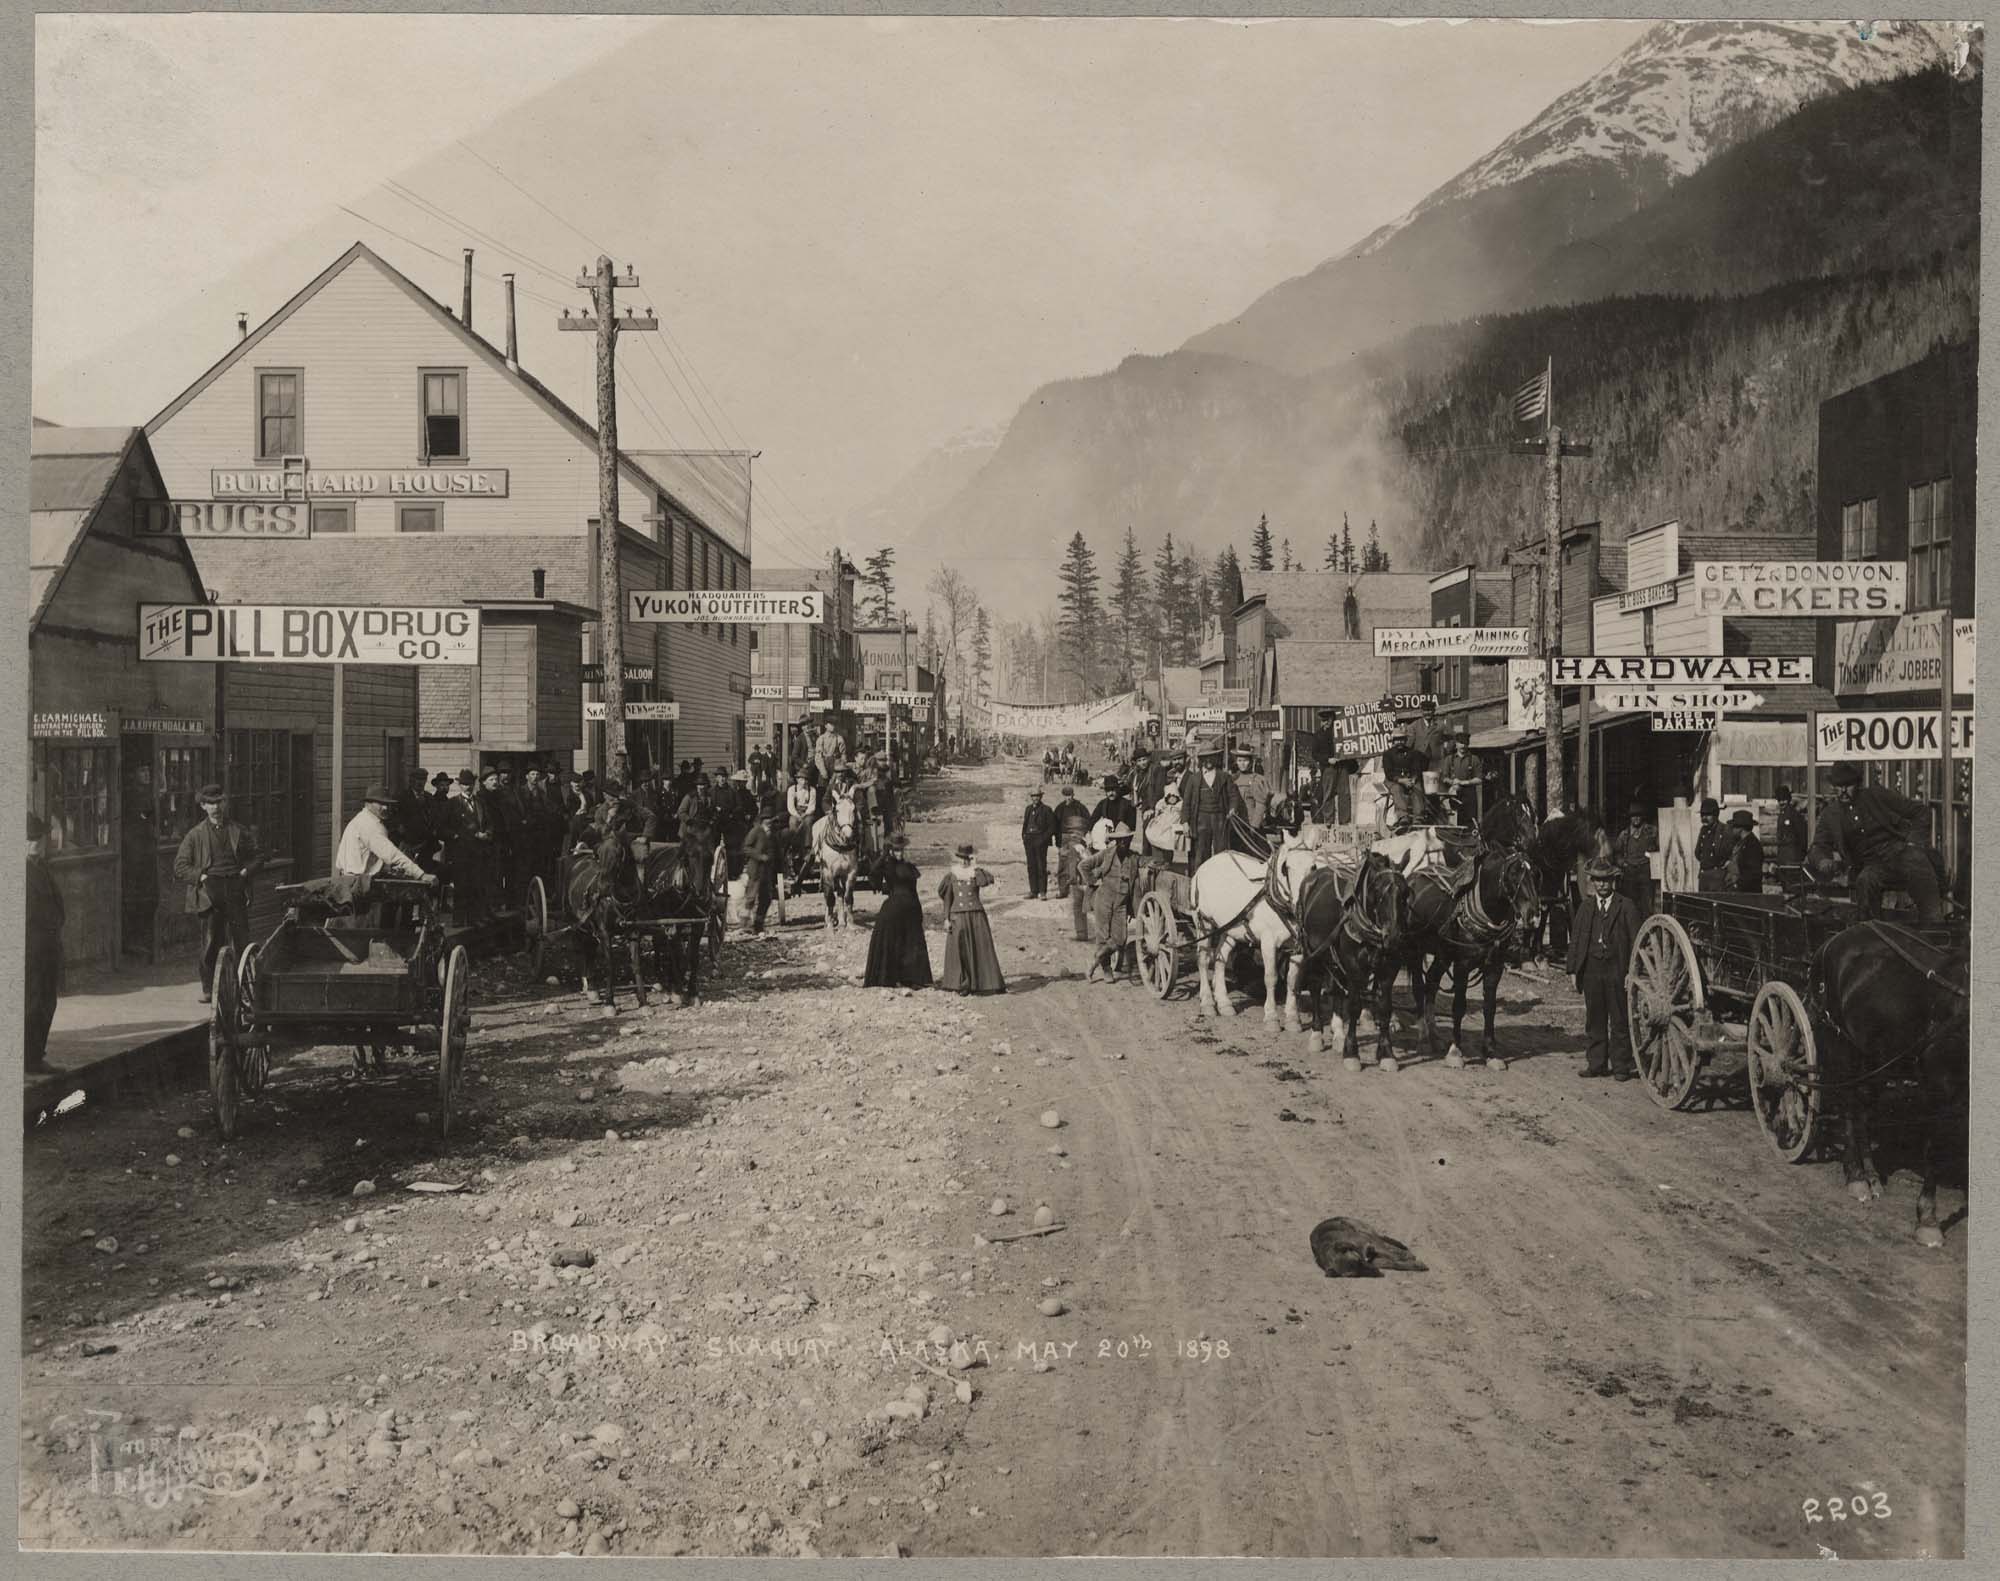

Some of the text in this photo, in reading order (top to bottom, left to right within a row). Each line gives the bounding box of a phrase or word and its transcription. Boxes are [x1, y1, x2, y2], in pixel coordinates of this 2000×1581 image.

[216, 473, 497, 493] BURKHARD HOUSE.
[143, 503, 305, 534] DRUGS.
[1784, 565, 1900, 582] DONOVON.
[634, 596, 820, 618] YUKON OUTFITTERS.
[1701, 587, 1902, 610] PACKERS.
[145, 609, 470, 658] THE PILL BOX DRUG
[1381, 635, 1463, 652] MERCANTILE
[1474, 630, 1520, 641] MINING
[399, 641, 449, 660] CO.
[1556, 659, 1811, 679] HARDWARE.
[1839, 661, 1882, 685] TINSMITH
[1366, 701, 1381, 713] THE
[1612, 692, 1748, 708] TIN SHOP
[42, 713, 107, 722] CARMICHAEL.
[1333, 717, 1358, 738] PILL
[1357, 714, 1380, 736] BOX
[1653, 718, 1717, 731] BAKERY.
[62, 729, 73, 737] THE
[77, 728, 91, 738] PILL
[1335, 732, 1393, 755] FOR DRUG
[1819, 721, 1845, 746] THE
